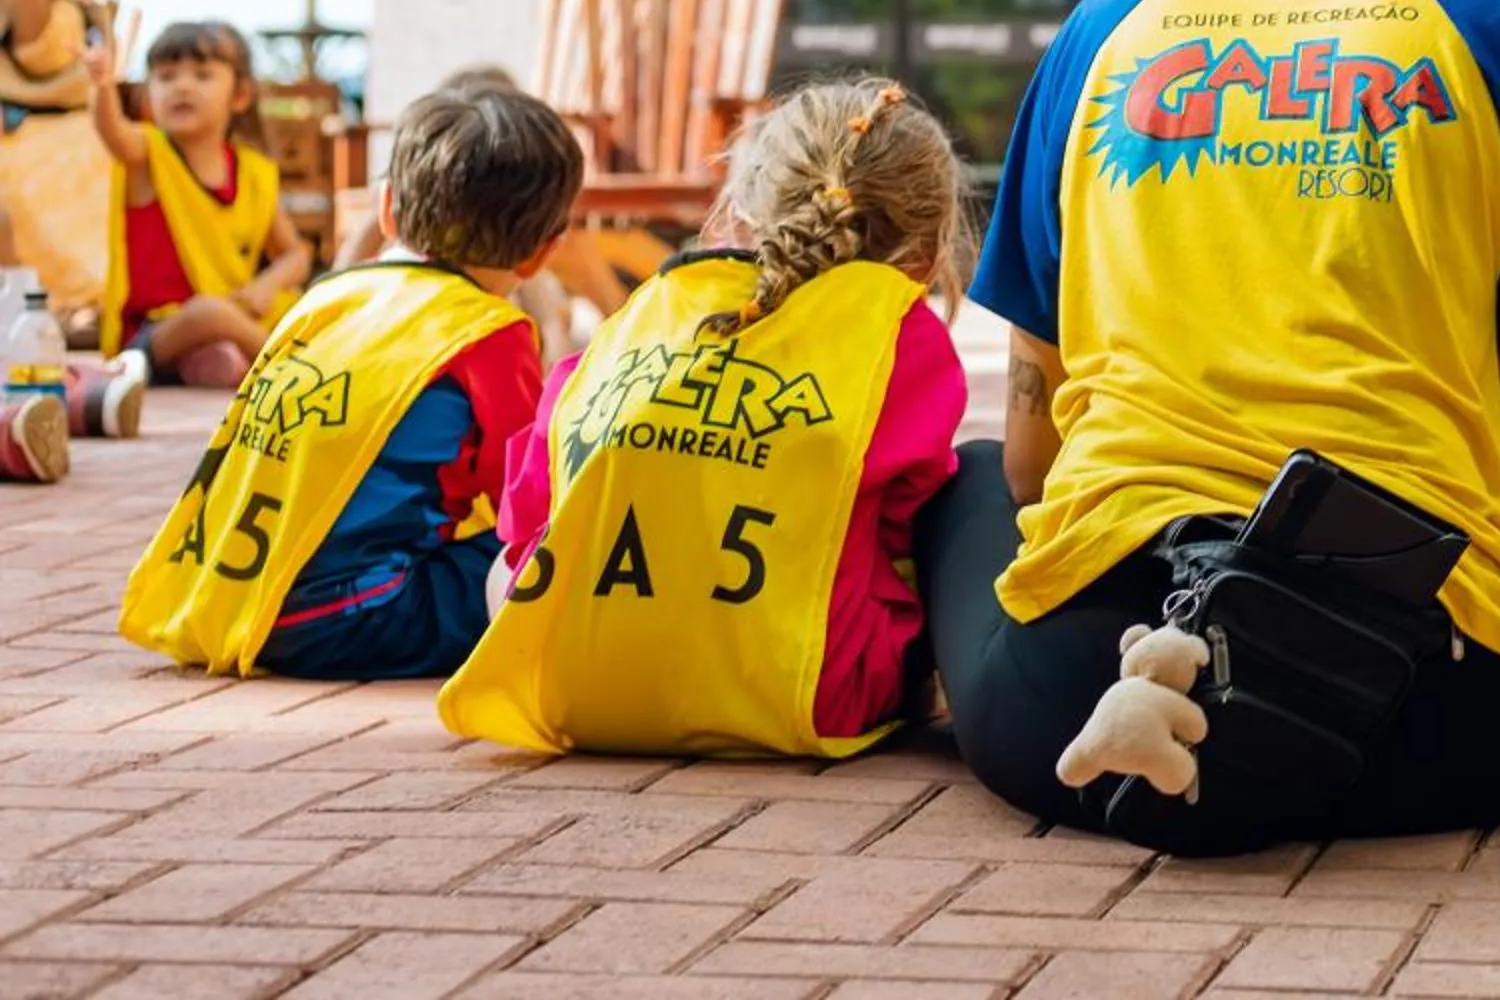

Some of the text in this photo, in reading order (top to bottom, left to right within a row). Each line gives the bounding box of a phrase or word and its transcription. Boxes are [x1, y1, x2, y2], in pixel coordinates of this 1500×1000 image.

[1162, 3, 1420, 30] EQUIPE DE RECREAÇÃO
[1122, 37, 1457, 142] GALERA
[1218, 140, 1397, 170] MONREALE
[607, 422, 771, 469] MONREALE
[214, 491, 284, 582] 5
[593, 503, 655, 598] A
[710, 504, 776, 604] 5
